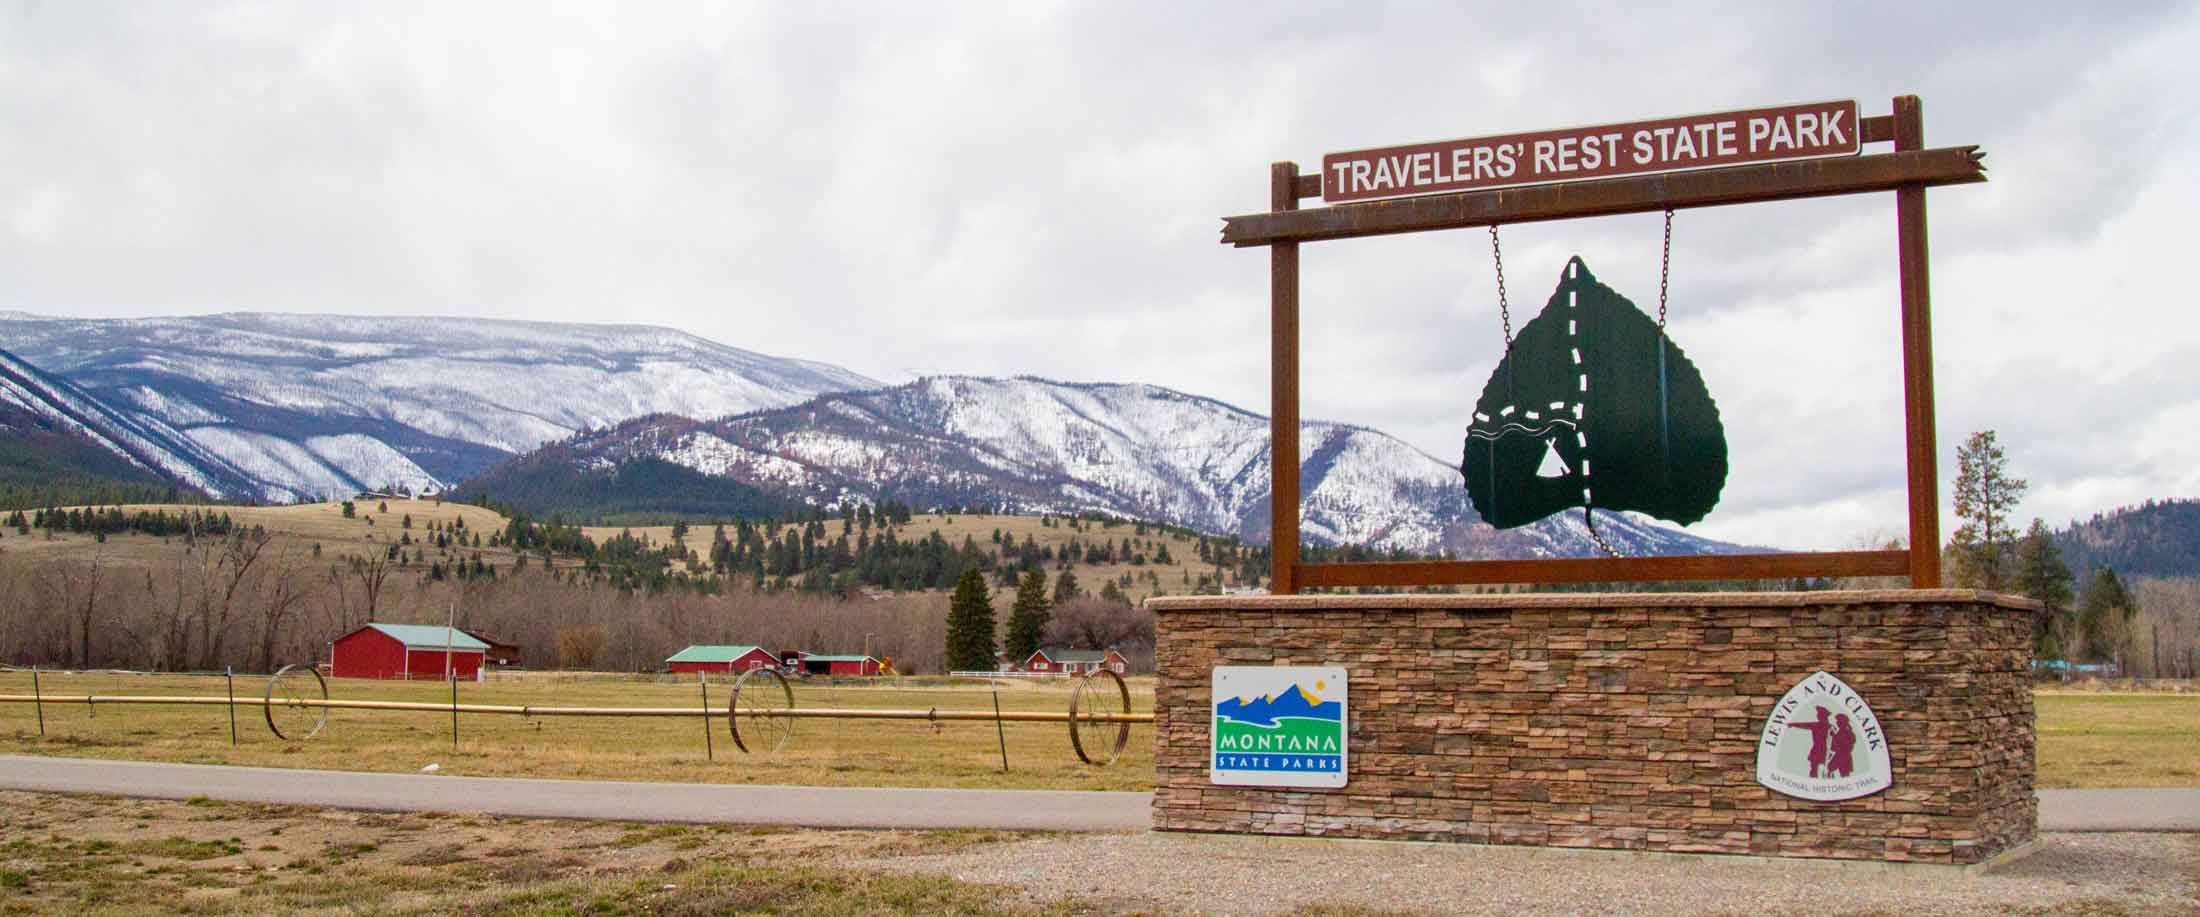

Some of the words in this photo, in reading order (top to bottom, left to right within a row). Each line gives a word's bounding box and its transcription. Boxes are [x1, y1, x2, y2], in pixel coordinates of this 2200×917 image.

[1535, 133, 1623, 174] REST
[1632, 121, 1737, 162] STATE
[1749, 110, 1847, 152] PARK
[1765, 697, 1799, 747] LEWIS
[1803, 680, 1842, 697] AND
[1845, 696, 1881, 751] CLARK
[1220, 734, 1337, 751] MONTANA
[1220, 757, 1270, 768] STATE
[1282, 758, 1337, 769] PARKS
[1770, 773, 1810, 792] NATIONAL
[1812, 784, 1854, 793] HISTORIC
